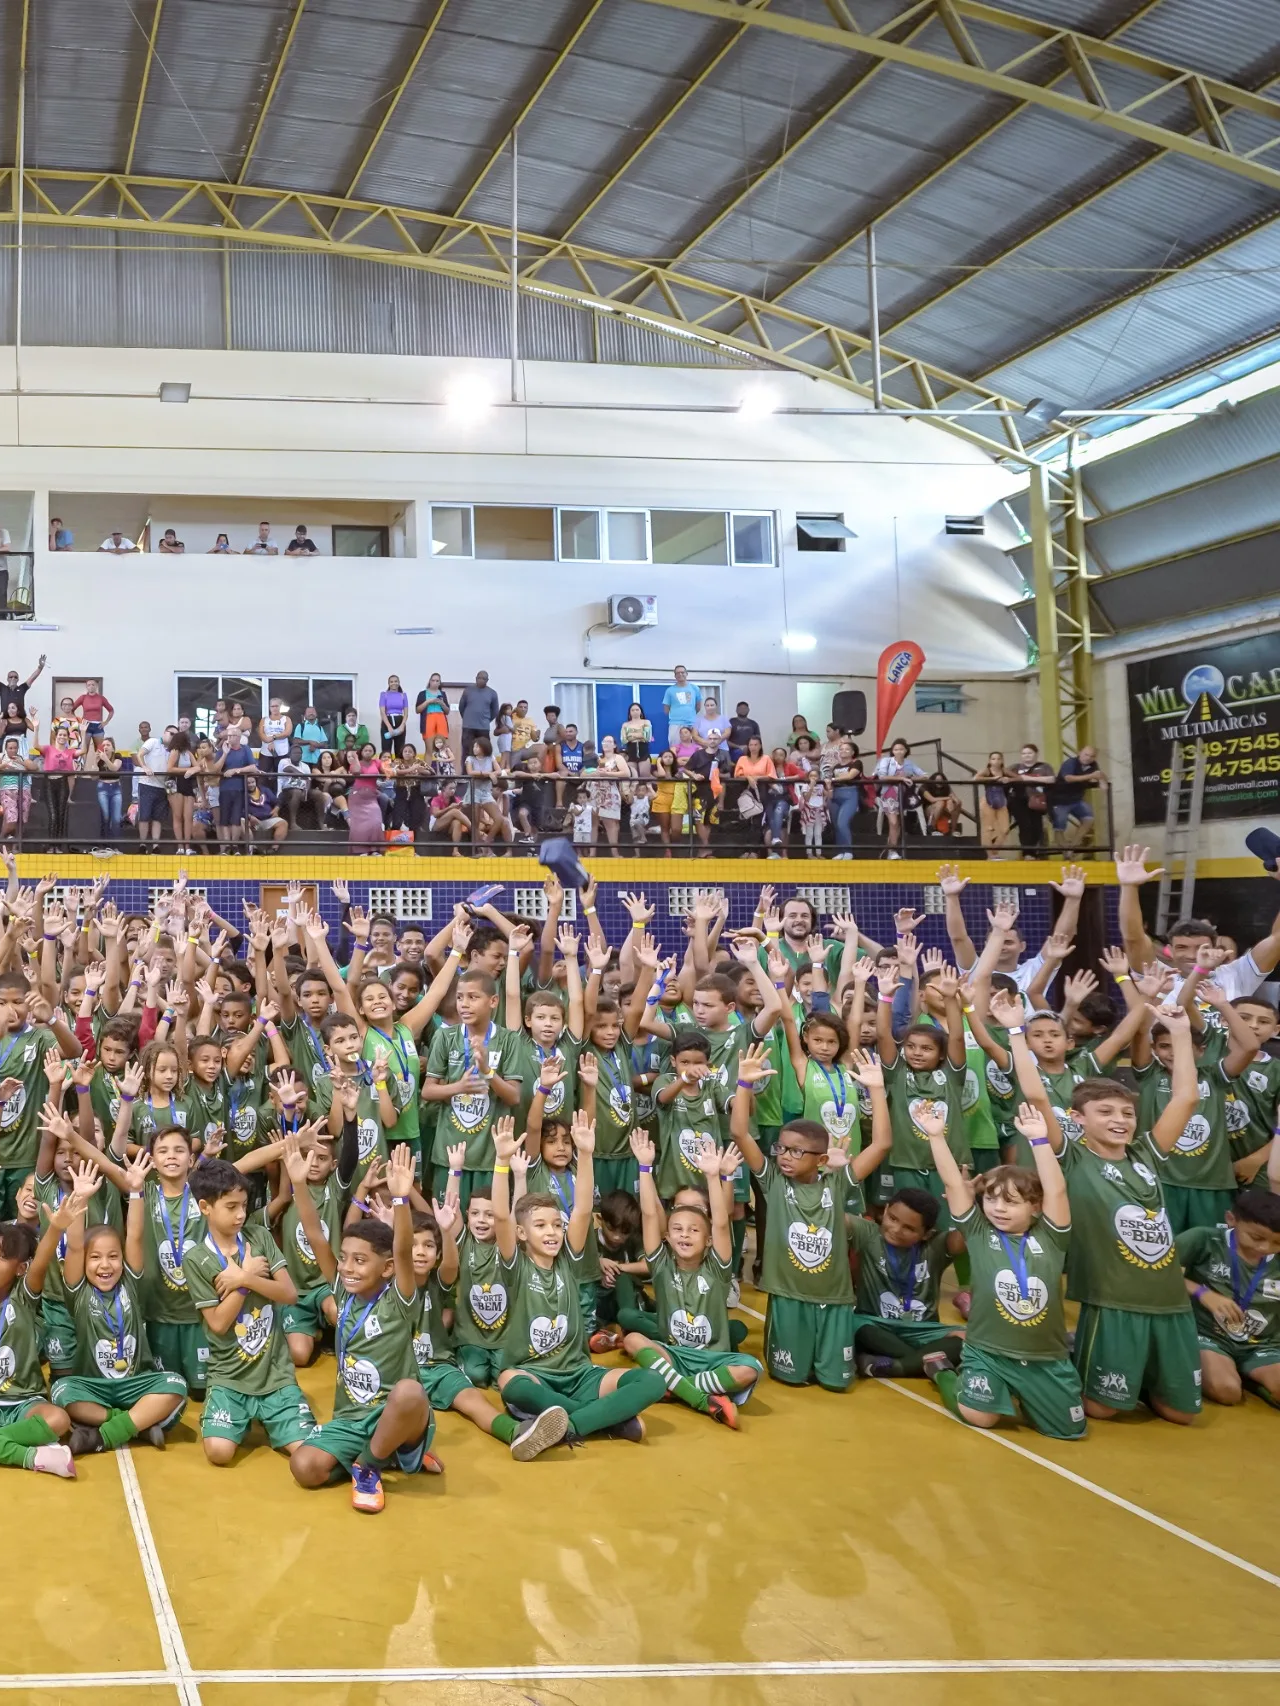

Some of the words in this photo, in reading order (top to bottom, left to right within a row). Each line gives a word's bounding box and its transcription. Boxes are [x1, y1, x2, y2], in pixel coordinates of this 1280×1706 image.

[888, 651, 913, 684] LANÇA
[1136, 685, 1186, 717] WIL
[1161, 711, 1268, 741] MULTIMARCAS
[459, 1102, 484, 1117] BEM
[358, 1135, 373, 1147] EM
[1183, 1129, 1203, 1141] EM
[790, 1231, 829, 1246] ESPORTE
[1132, 1229, 1170, 1247] BEM
[797, 1240, 827, 1257] BEM
[472, 1293, 503, 1302] ESPORTE
[477, 1301, 502, 1312] BEM
[673, 1319, 708, 1335] ESPORTE
[679, 1331, 706, 1345] BEM
